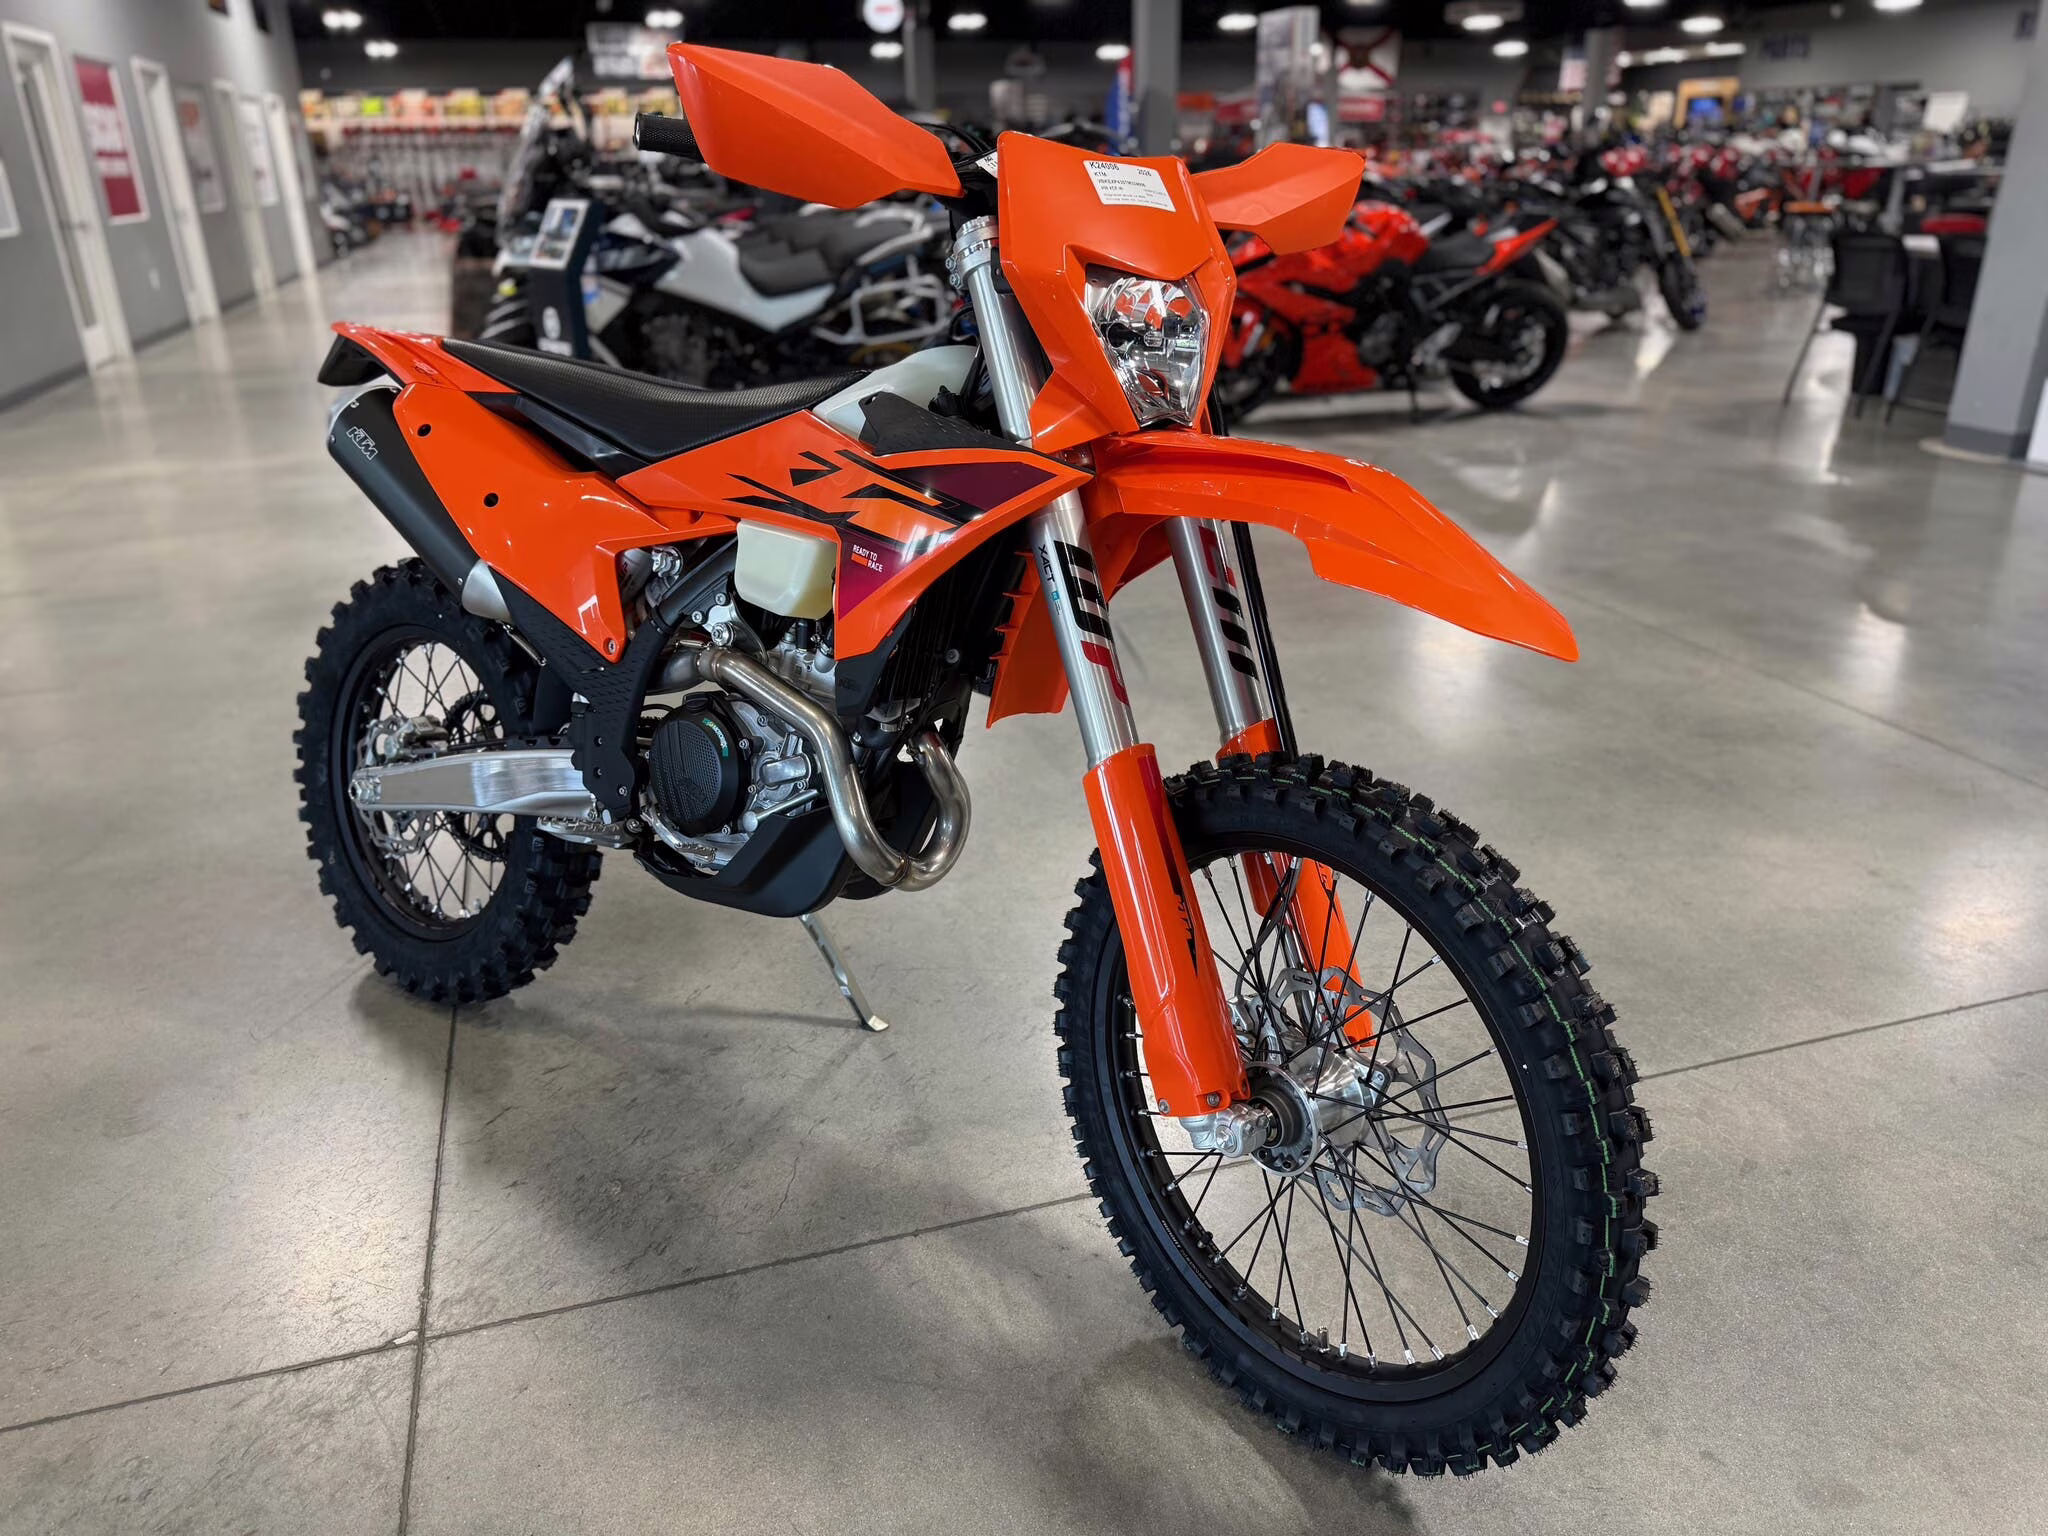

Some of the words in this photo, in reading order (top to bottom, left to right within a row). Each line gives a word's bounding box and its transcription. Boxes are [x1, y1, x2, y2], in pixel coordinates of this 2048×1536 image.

[346, 426, 378, 460] KTM
[852, 544, 869, 558] READY
[870, 551, 878, 561] TO
[1038, 543, 1055, 583] XACT
[867, 559, 884, 573] RACE
